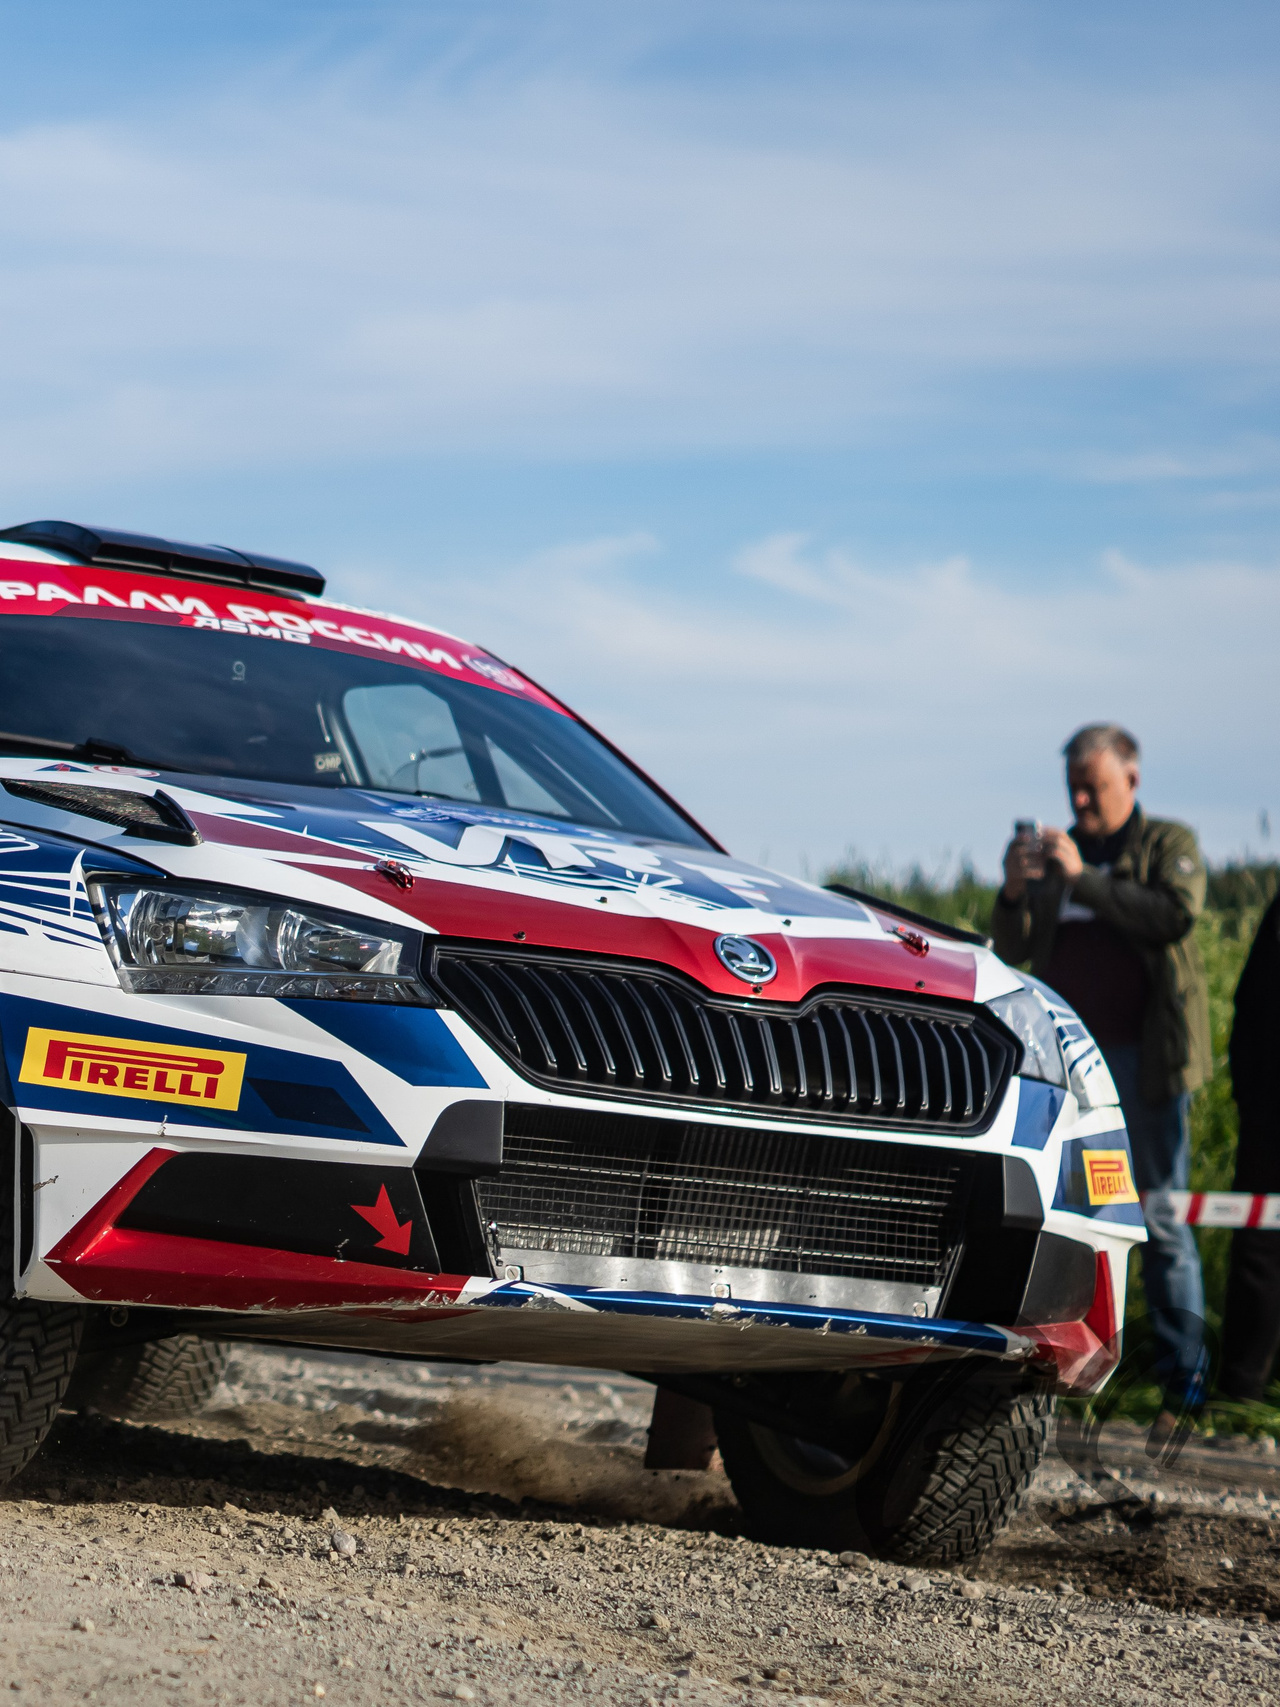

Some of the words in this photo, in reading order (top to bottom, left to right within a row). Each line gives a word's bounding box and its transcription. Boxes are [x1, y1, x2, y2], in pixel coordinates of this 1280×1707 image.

[227, 602, 463, 671] РОССИИ
[43, 1039, 224, 1099] PIRELLI
[1089, 1160, 1129, 1196] PIRELLI
